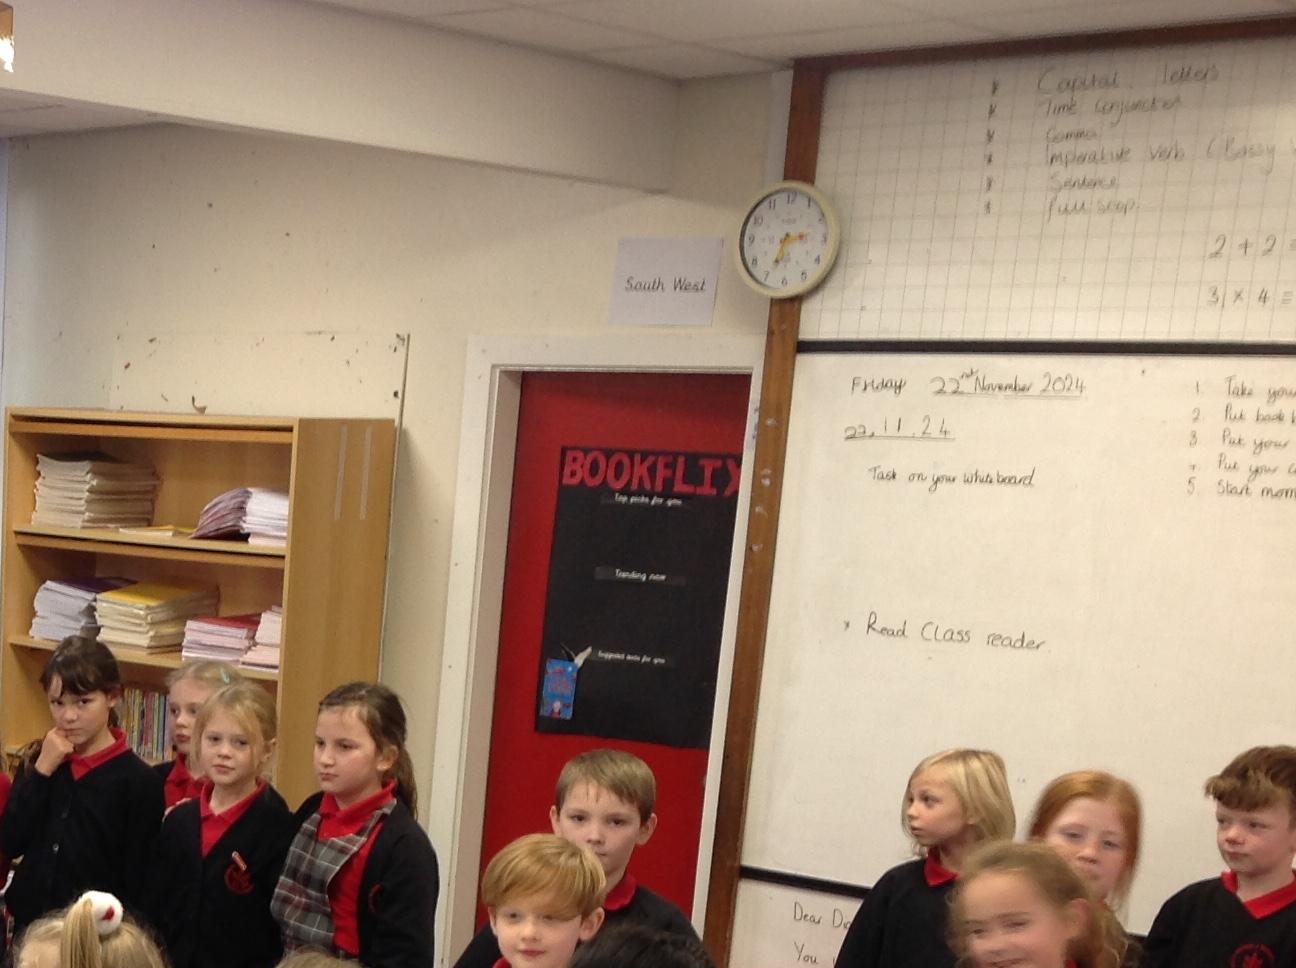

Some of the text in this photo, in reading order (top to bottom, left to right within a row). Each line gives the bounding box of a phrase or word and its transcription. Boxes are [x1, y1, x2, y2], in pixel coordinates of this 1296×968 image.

[625, 276, 706, 292] South West
[851, 376, 907, 396] Friday
[975, 375, 1033, 393] November
[1040, 372, 1087, 394] 2024
[1224, 375, 1254, 397] Take
[1266, 386, 1296, 406] you
[1224, 402, 1245, 421] Put
[1222, 427, 1245, 446] Put
[1253, 439, 1290, 456] your
[868, 465, 897, 481] Task
[908, 471, 927, 483] on
[928, 473, 956, 493] your
[1247, 463, 1279, 483] your
[1217, 479, 1251, 495] Start
[866, 610, 908, 638] Read
[986, 631, 1046, 650] reader
[793, 901, 823, 925] Dear
[794, 941, 819, 965] You
